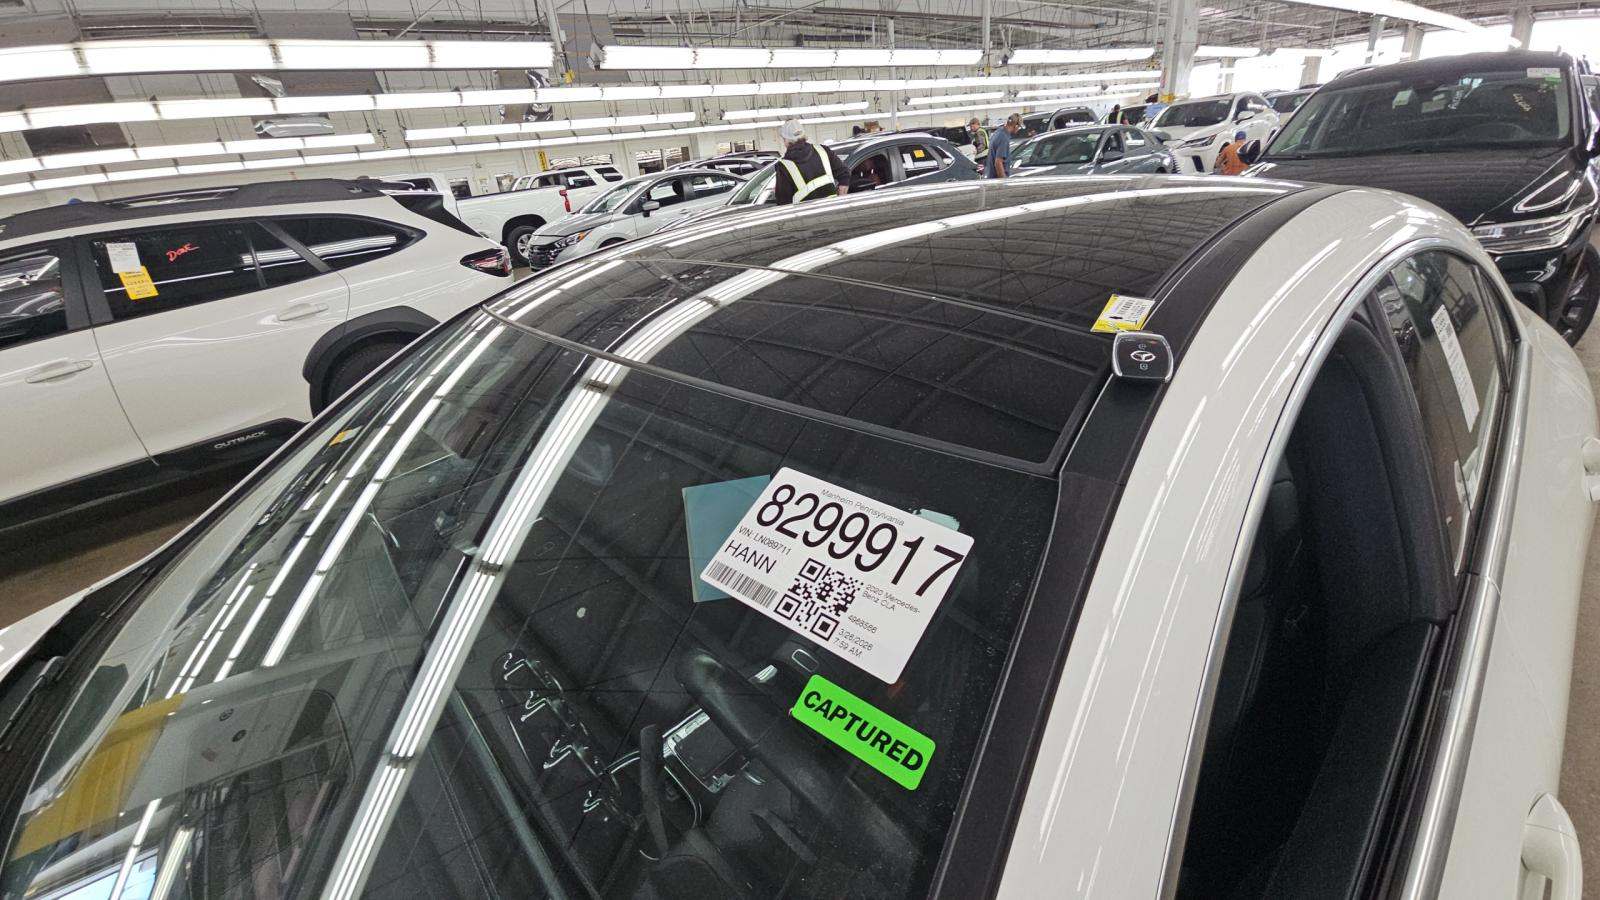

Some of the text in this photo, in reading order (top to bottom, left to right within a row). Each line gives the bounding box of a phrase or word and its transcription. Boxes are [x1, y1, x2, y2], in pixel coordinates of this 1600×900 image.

[214, 431, 266, 449] OUTBACK
[820, 488, 905, 526] Manheim Pennsylvania
[754, 533, 792, 555] LN089711
[756, 484, 965, 598] 8299917
[724, 539, 777, 574] HANN
[862, 590, 896, 612] Benz CLA
[866, 583, 884, 597] 2020
[849, 646, 863, 658] AM
[803, 690, 924, 771] CAPTURED
